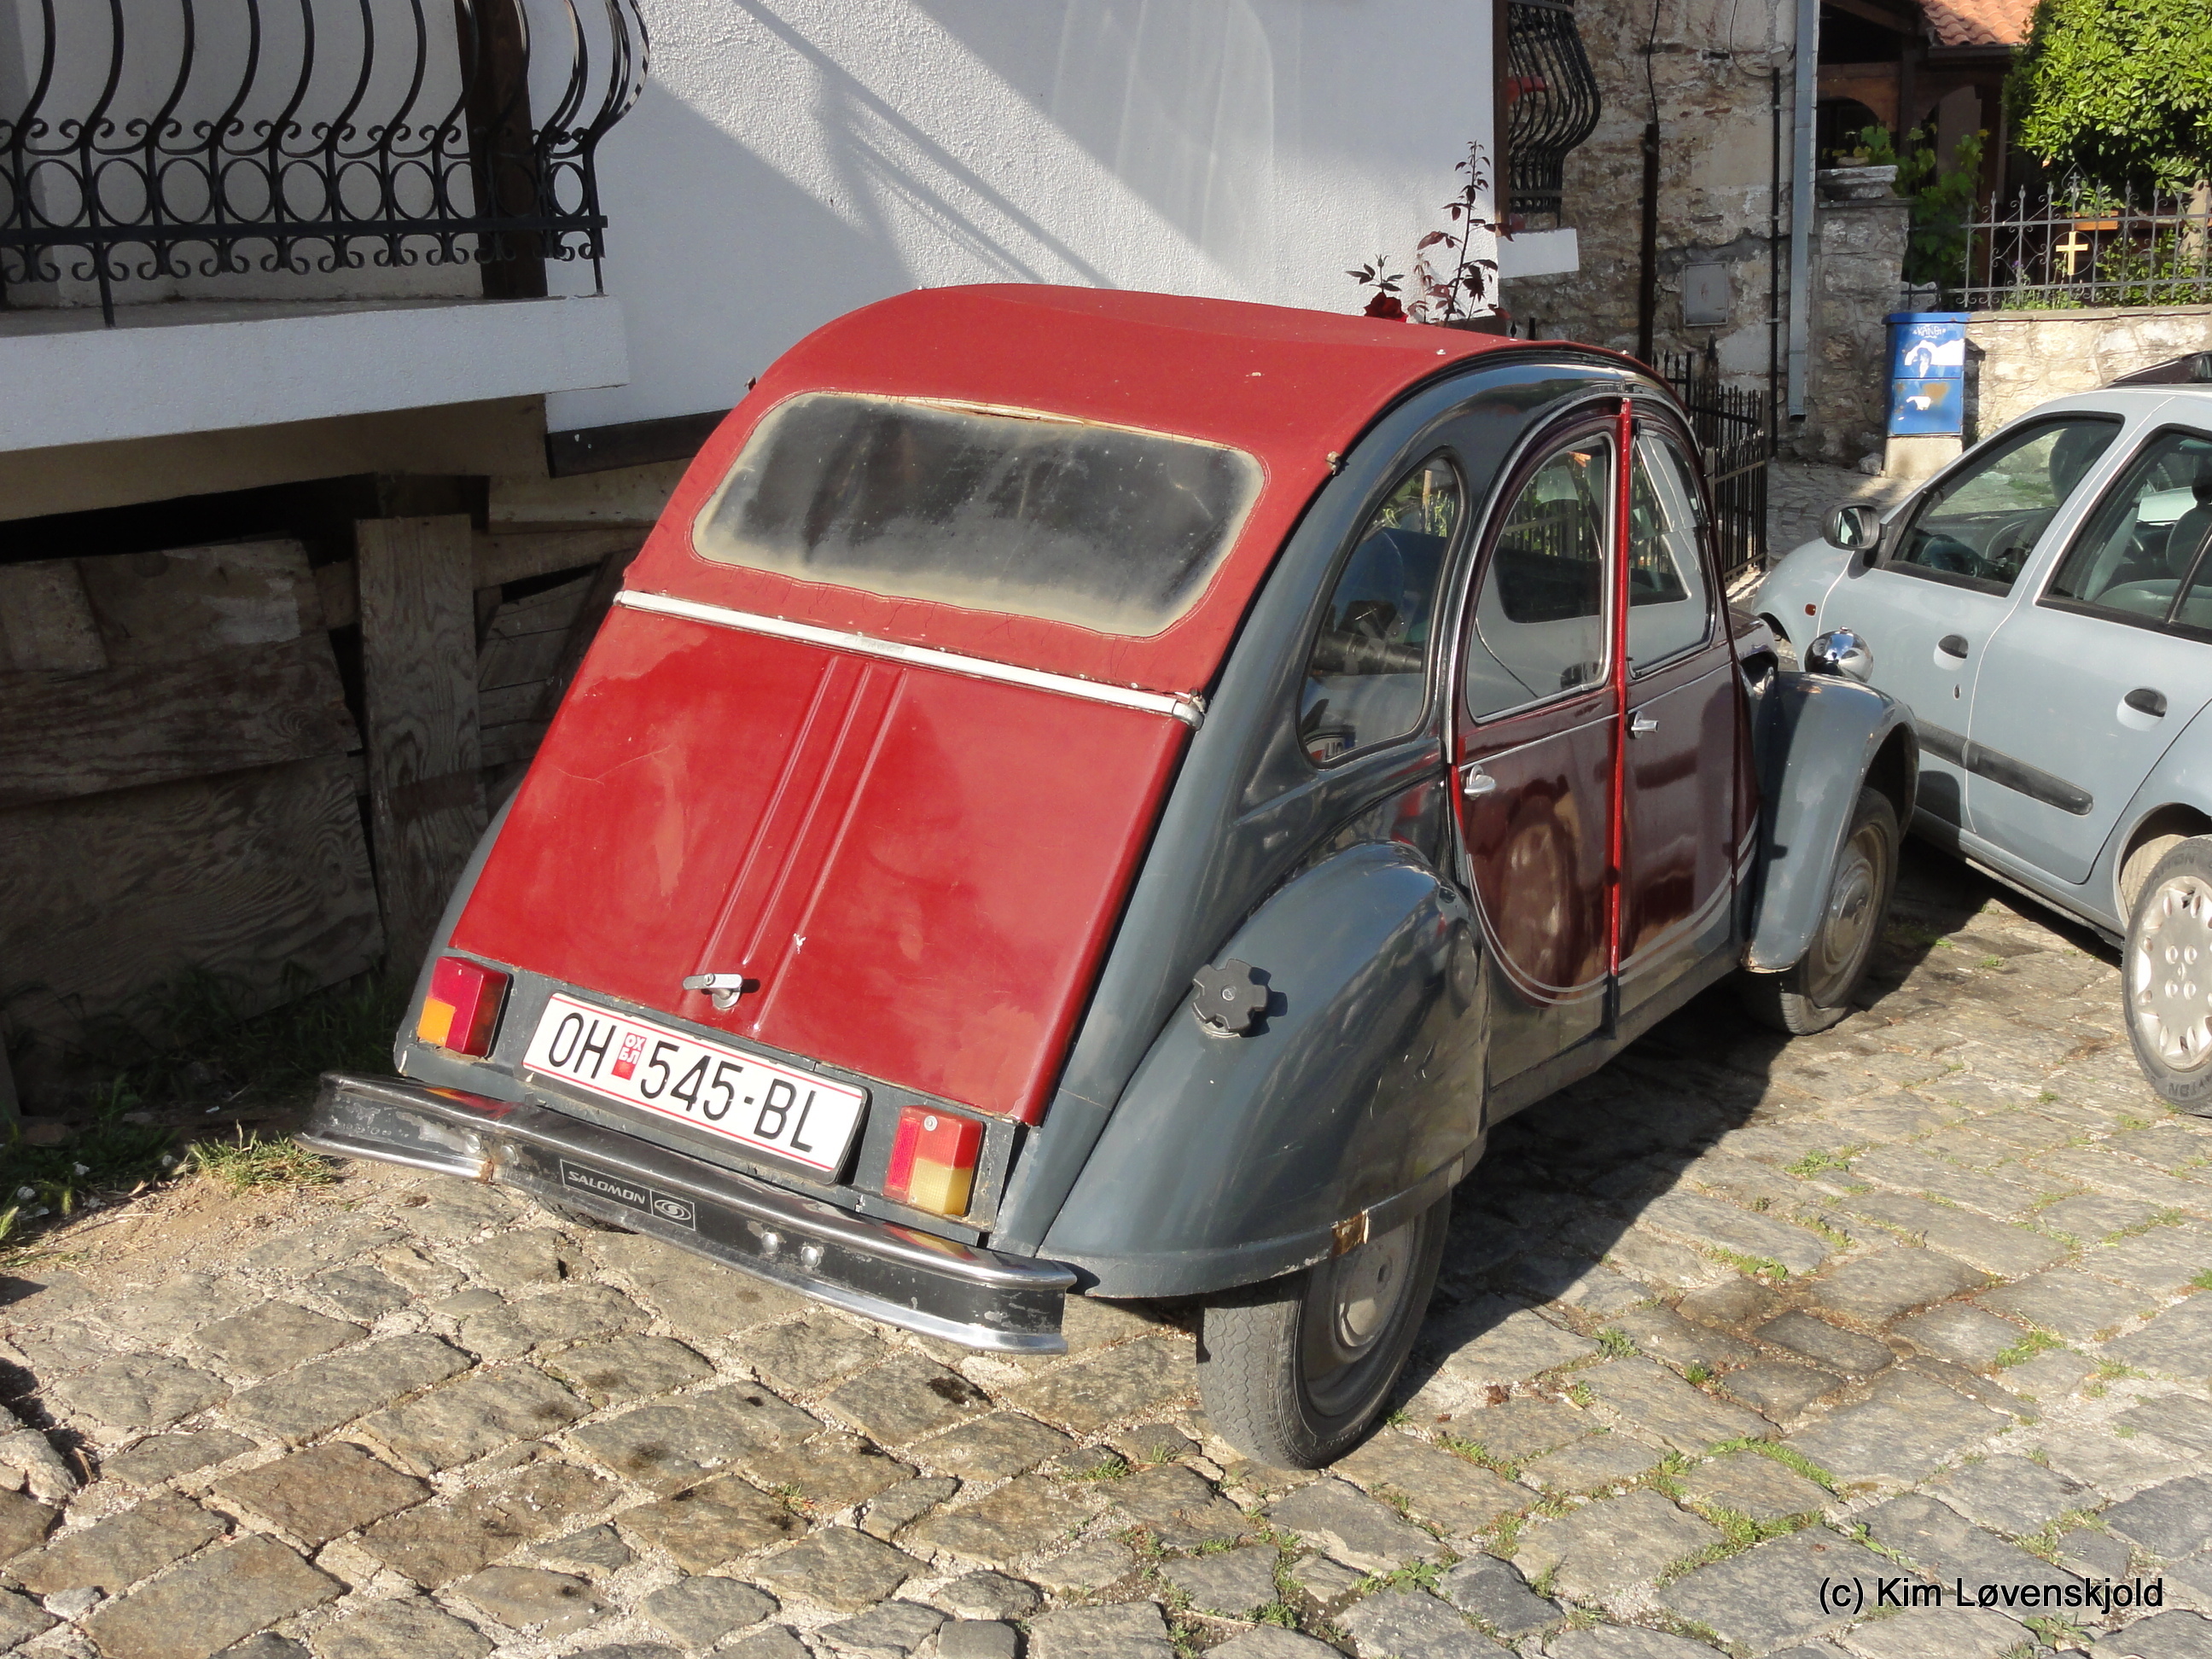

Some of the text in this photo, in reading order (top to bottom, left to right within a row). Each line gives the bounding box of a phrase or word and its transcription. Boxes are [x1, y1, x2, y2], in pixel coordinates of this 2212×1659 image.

[548, 1012, 817, 1153] OH 545-BL
[568, 1171, 645, 1204] SALOMON
